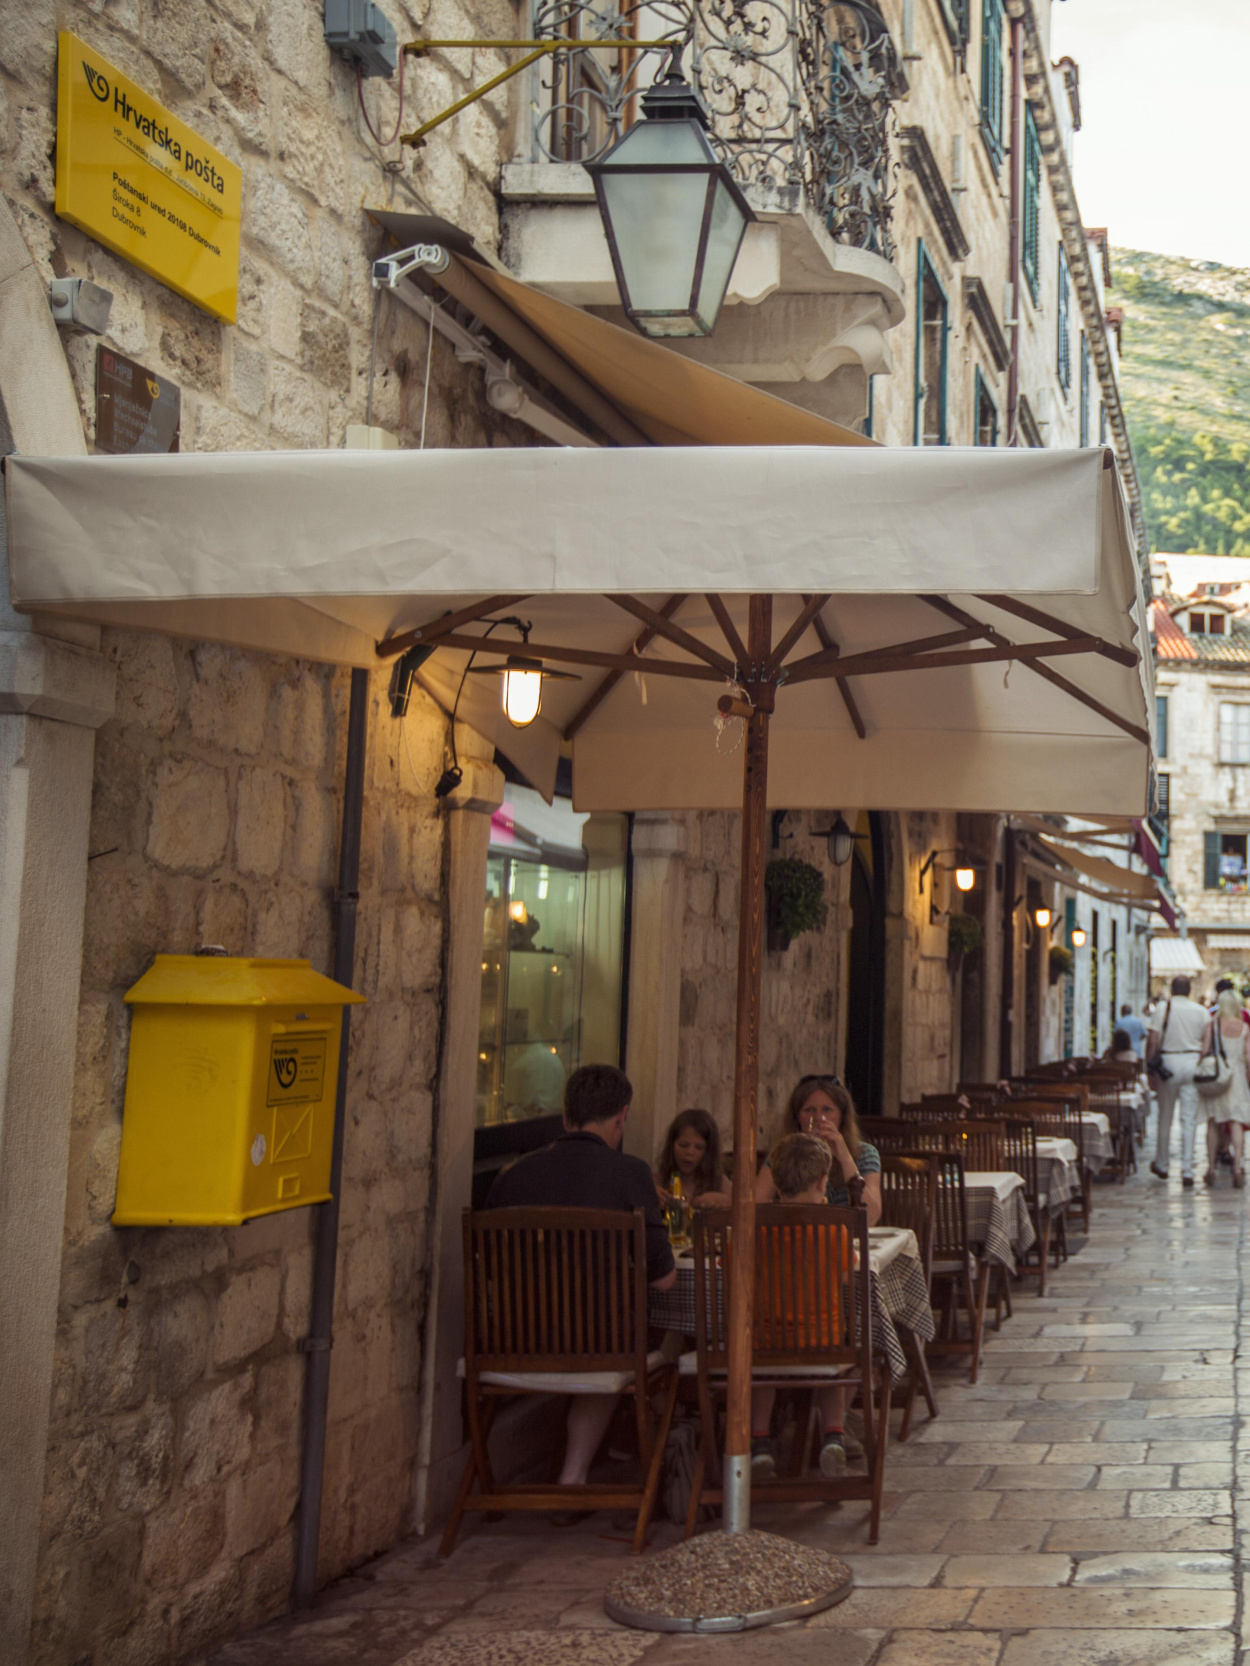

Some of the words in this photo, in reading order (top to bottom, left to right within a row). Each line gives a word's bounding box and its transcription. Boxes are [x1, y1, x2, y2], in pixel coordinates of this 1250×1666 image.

[114, 87, 182, 162] Hrvatska
[185, 150, 224, 194] pošta
[112, 188, 135, 213] Široka
[112, 205, 147, 239] Dubrovnik
[113, 171, 149, 205] Poštanski
[150, 200, 166, 217] ured
[188, 226, 221, 257] Dubrovnik
